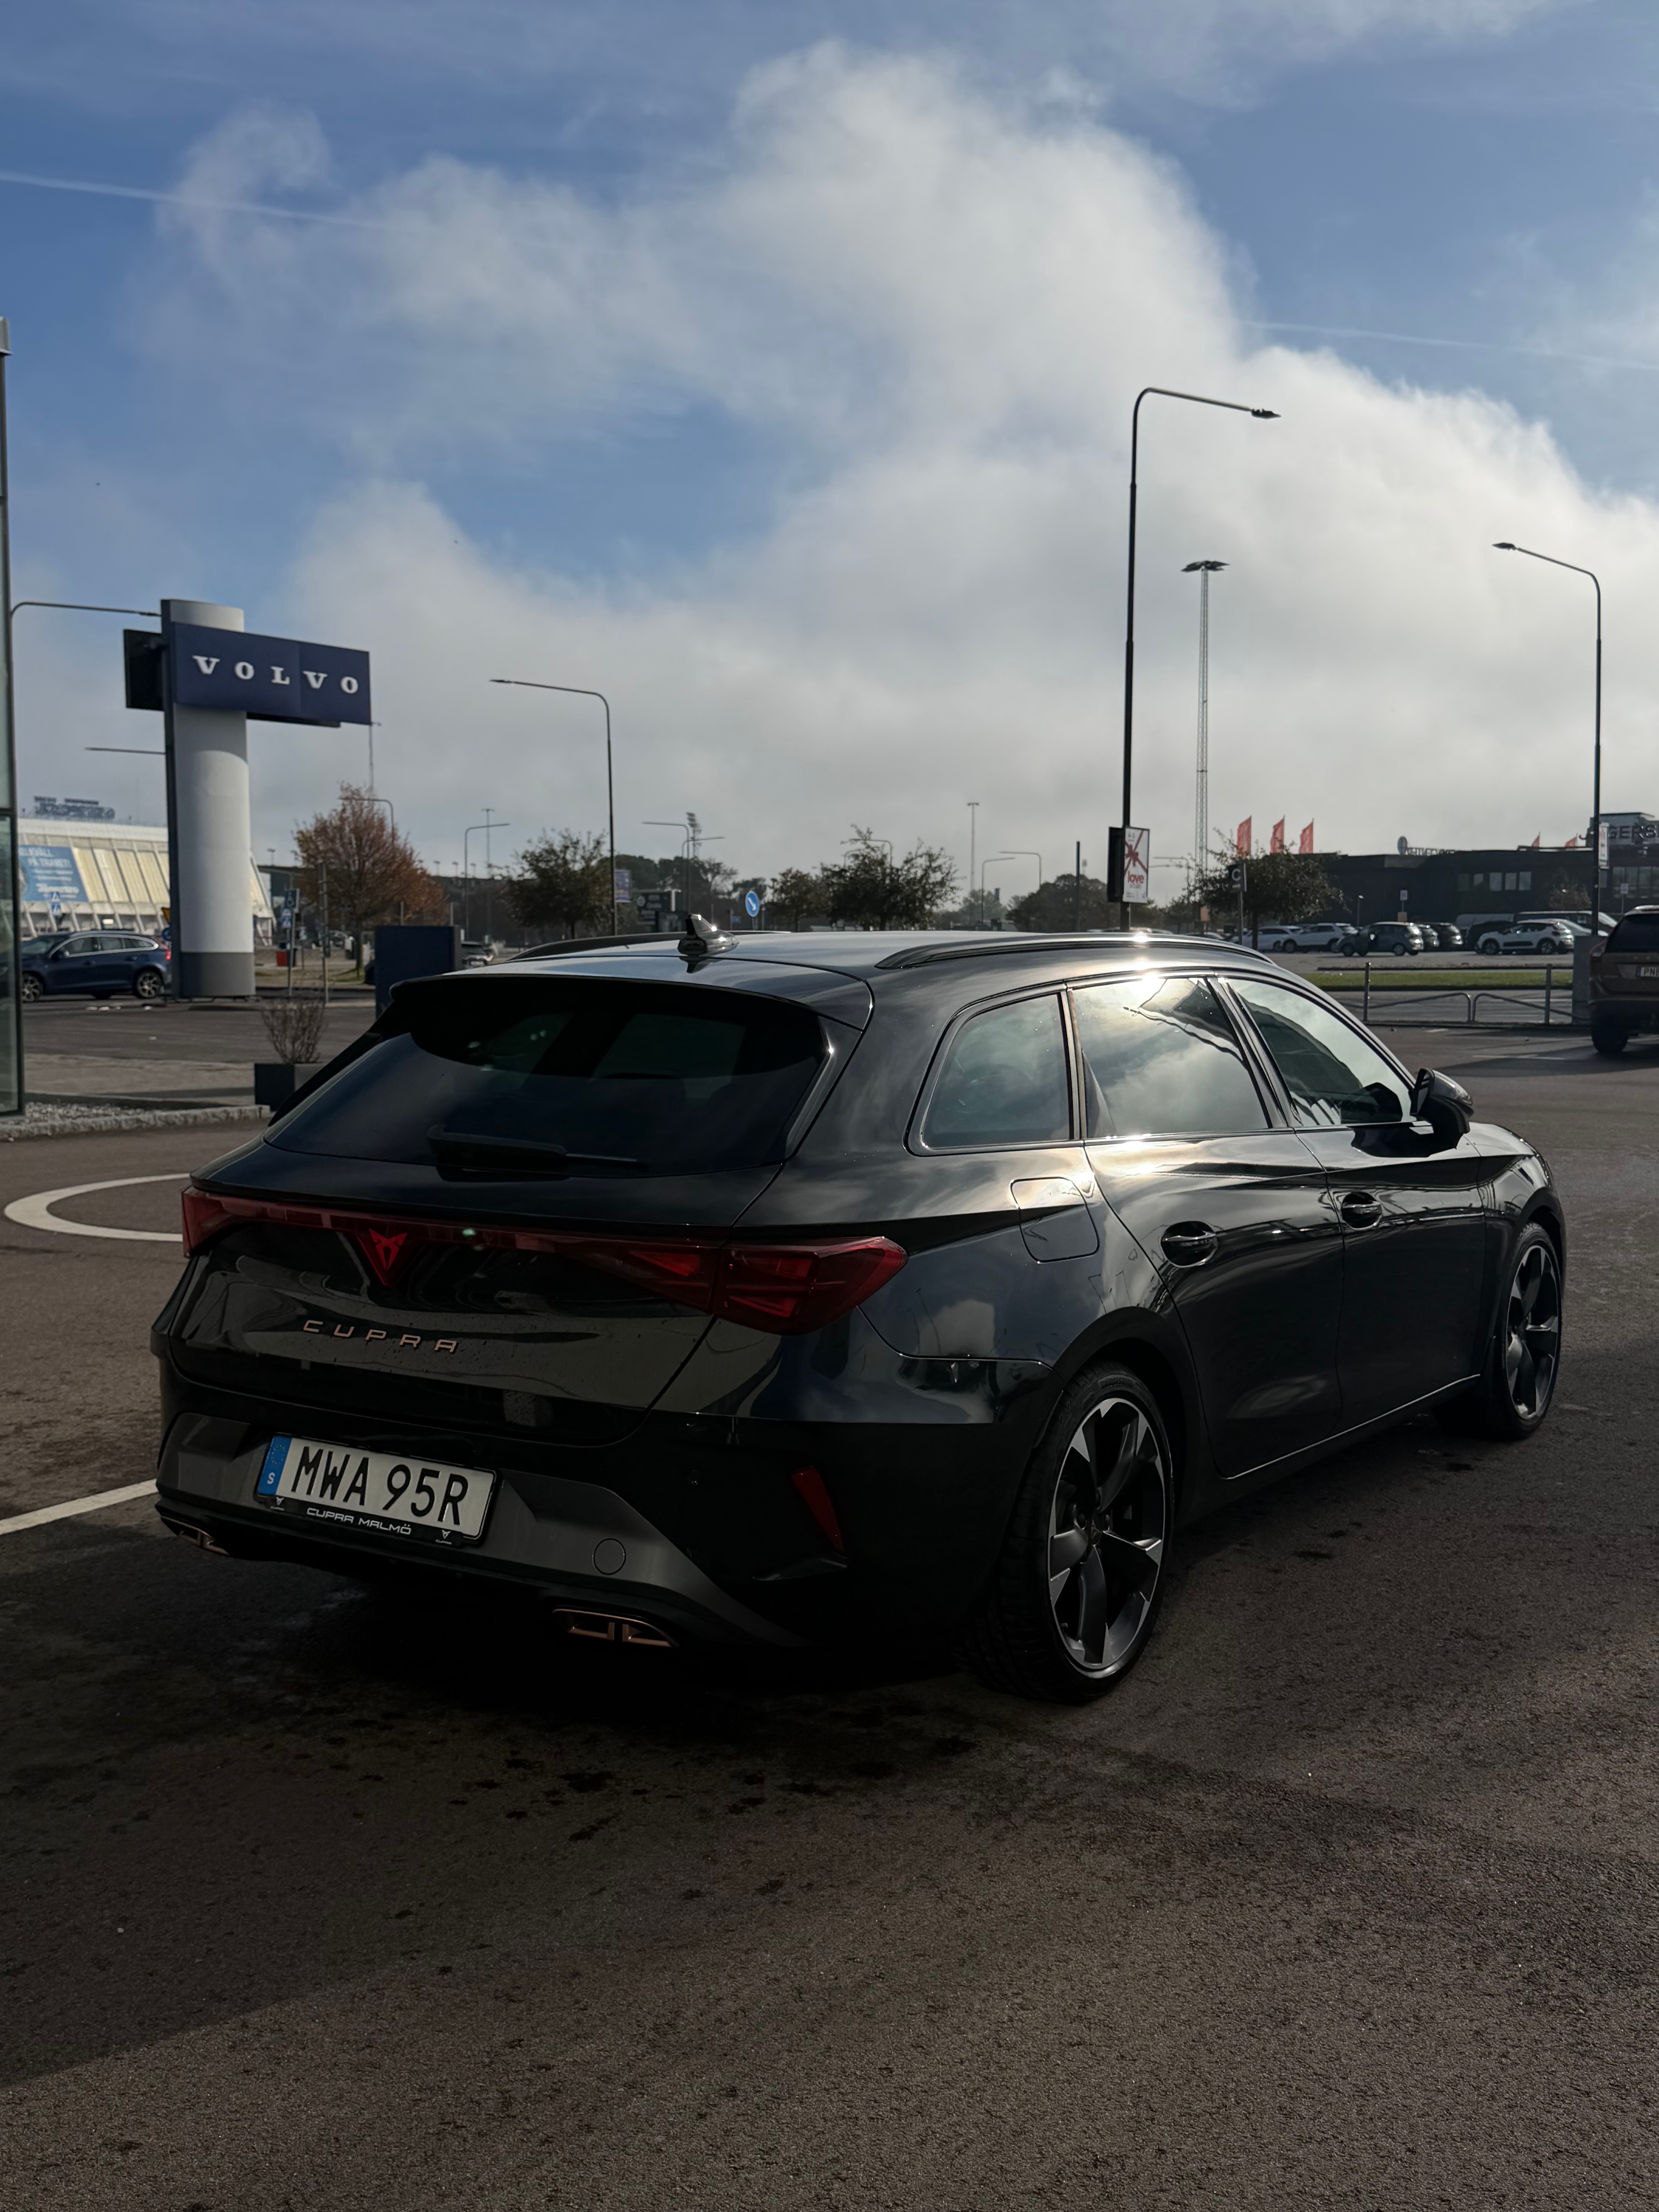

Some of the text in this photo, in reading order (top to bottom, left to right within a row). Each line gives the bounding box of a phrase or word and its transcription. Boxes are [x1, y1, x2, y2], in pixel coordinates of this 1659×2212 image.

[192, 655, 359, 694] VOLVO
[1127, 871, 1144, 884] love
[1232, 868, 1240, 881] C
[303, 1320, 457, 1353] CUPRA
[267, 1472, 275, 1485] S
[291, 1446, 469, 1525] MWA 95R
[307, 1508, 412, 1535] CUPRA MALMÖ
